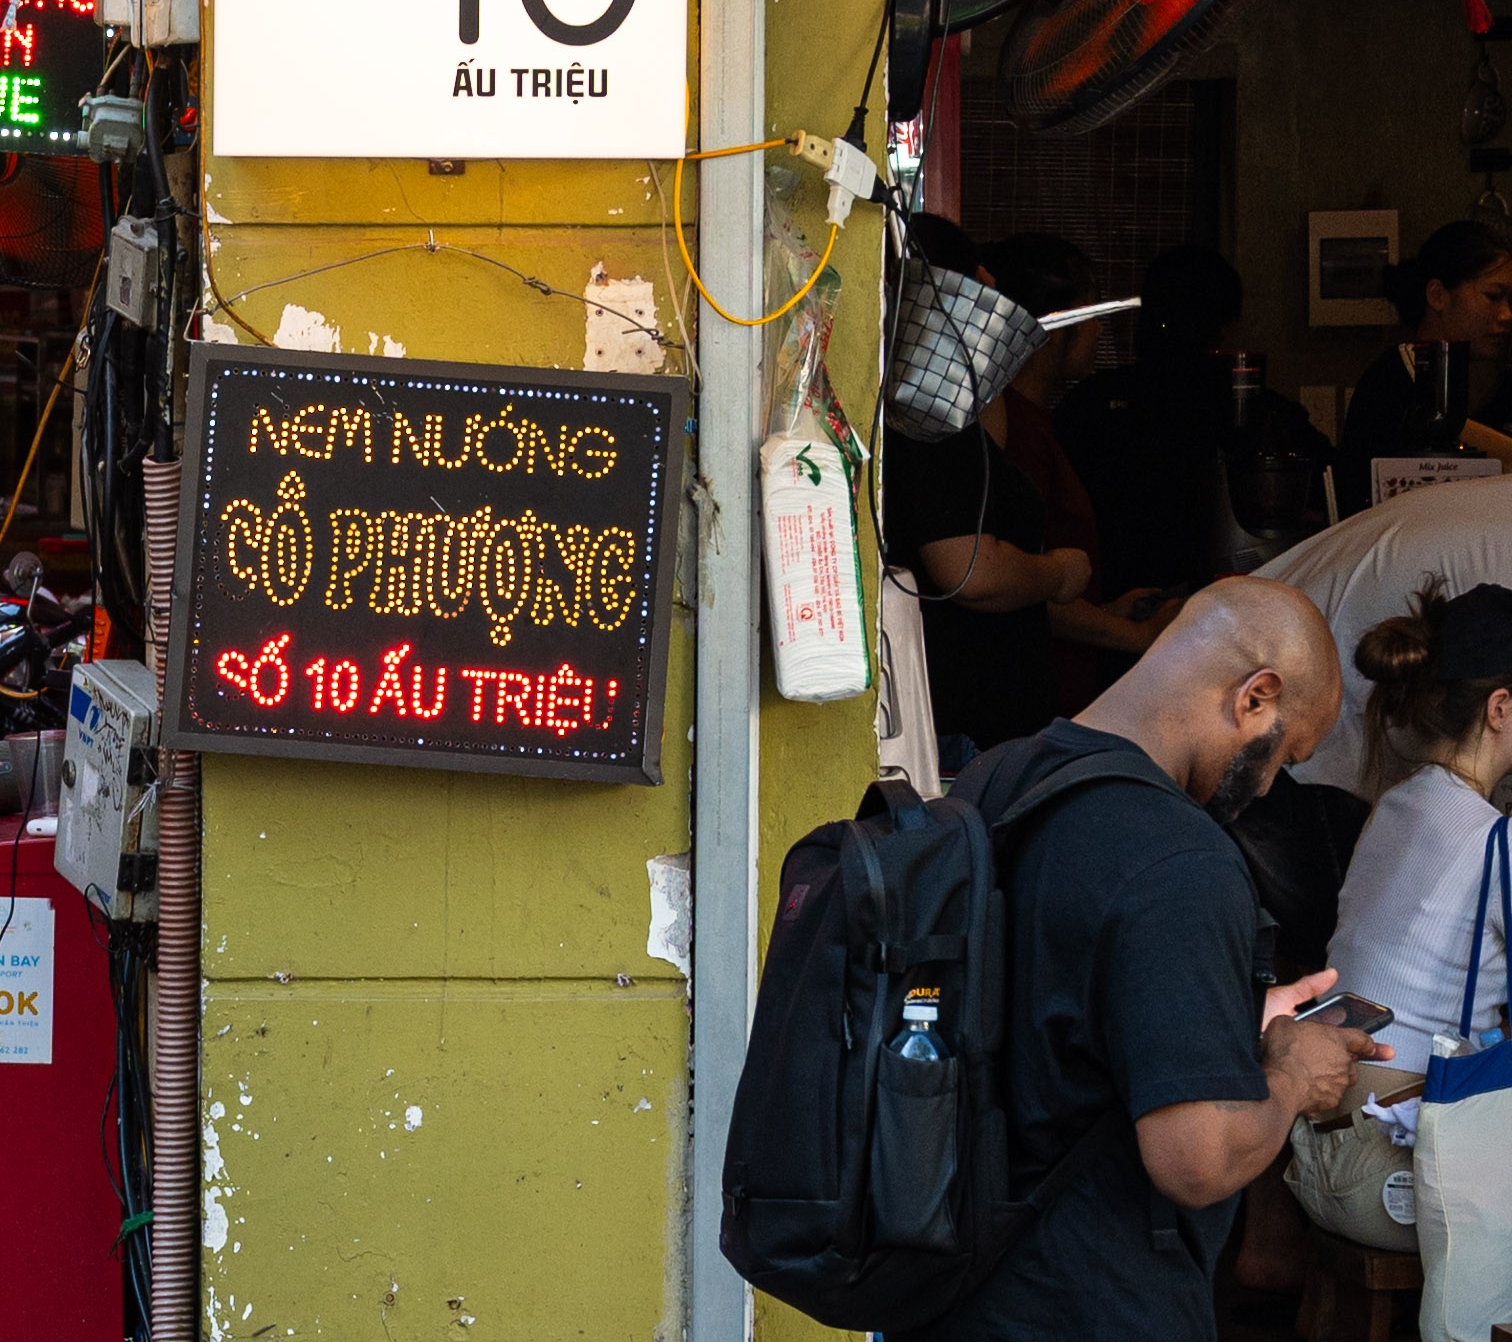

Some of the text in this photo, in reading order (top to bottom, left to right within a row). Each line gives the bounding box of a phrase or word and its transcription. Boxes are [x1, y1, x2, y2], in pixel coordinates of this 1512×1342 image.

[452, 58, 608, 105] ẤU TRIỆU
[249, 404, 618, 479] NEM NƯỚNG
[217, 470, 313, 606] CÔ
[324, 506, 637, 645] PHƯỢNG
[306, 659, 360, 711] 10
[370, 641, 447, 718] ẤU
[462, 662, 618, 735] TRIỆU
[11, 955, 40, 967] BAY
